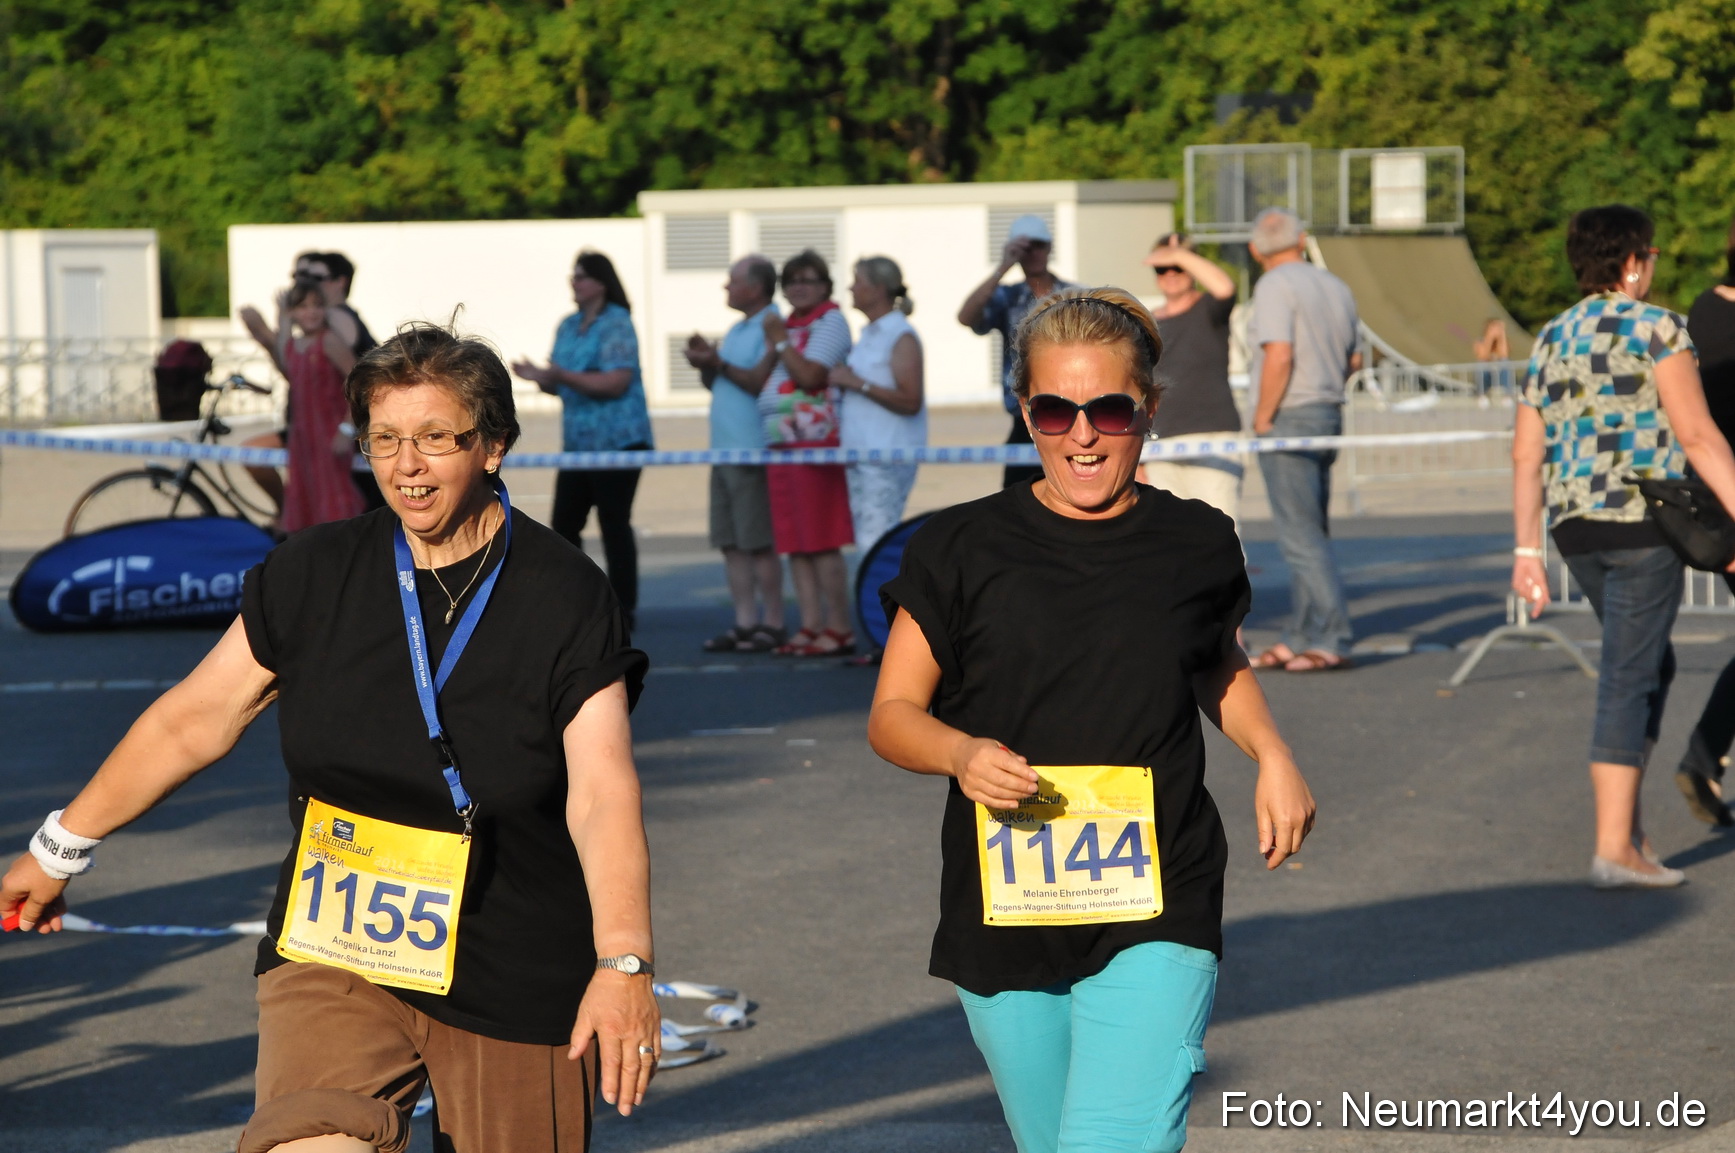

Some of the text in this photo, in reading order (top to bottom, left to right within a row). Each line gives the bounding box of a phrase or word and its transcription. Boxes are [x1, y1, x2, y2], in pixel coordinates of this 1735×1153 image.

[410, 616, 427, 688] www.bayern.landtag.de
[988, 810, 1035, 823] walken
[322, 831, 374, 857] firmenlauf
[987, 822, 1151, 884] 1144
[307, 845, 345, 868] walken
[992, 896, 1153, 912] Regens-Wagner-Stiftung Holnstein KdöR
[1023, 887, 1119, 898] Melanie Ehrenberger
[301, 860, 450, 951] 1155
[288, 936, 375, 969] Regens-Wagner-Stiftung
[378, 961, 417, 974] Holnstein
[420, 968, 443, 978] KdöR
[332, 935, 396, 958] Angelika Lanzl
